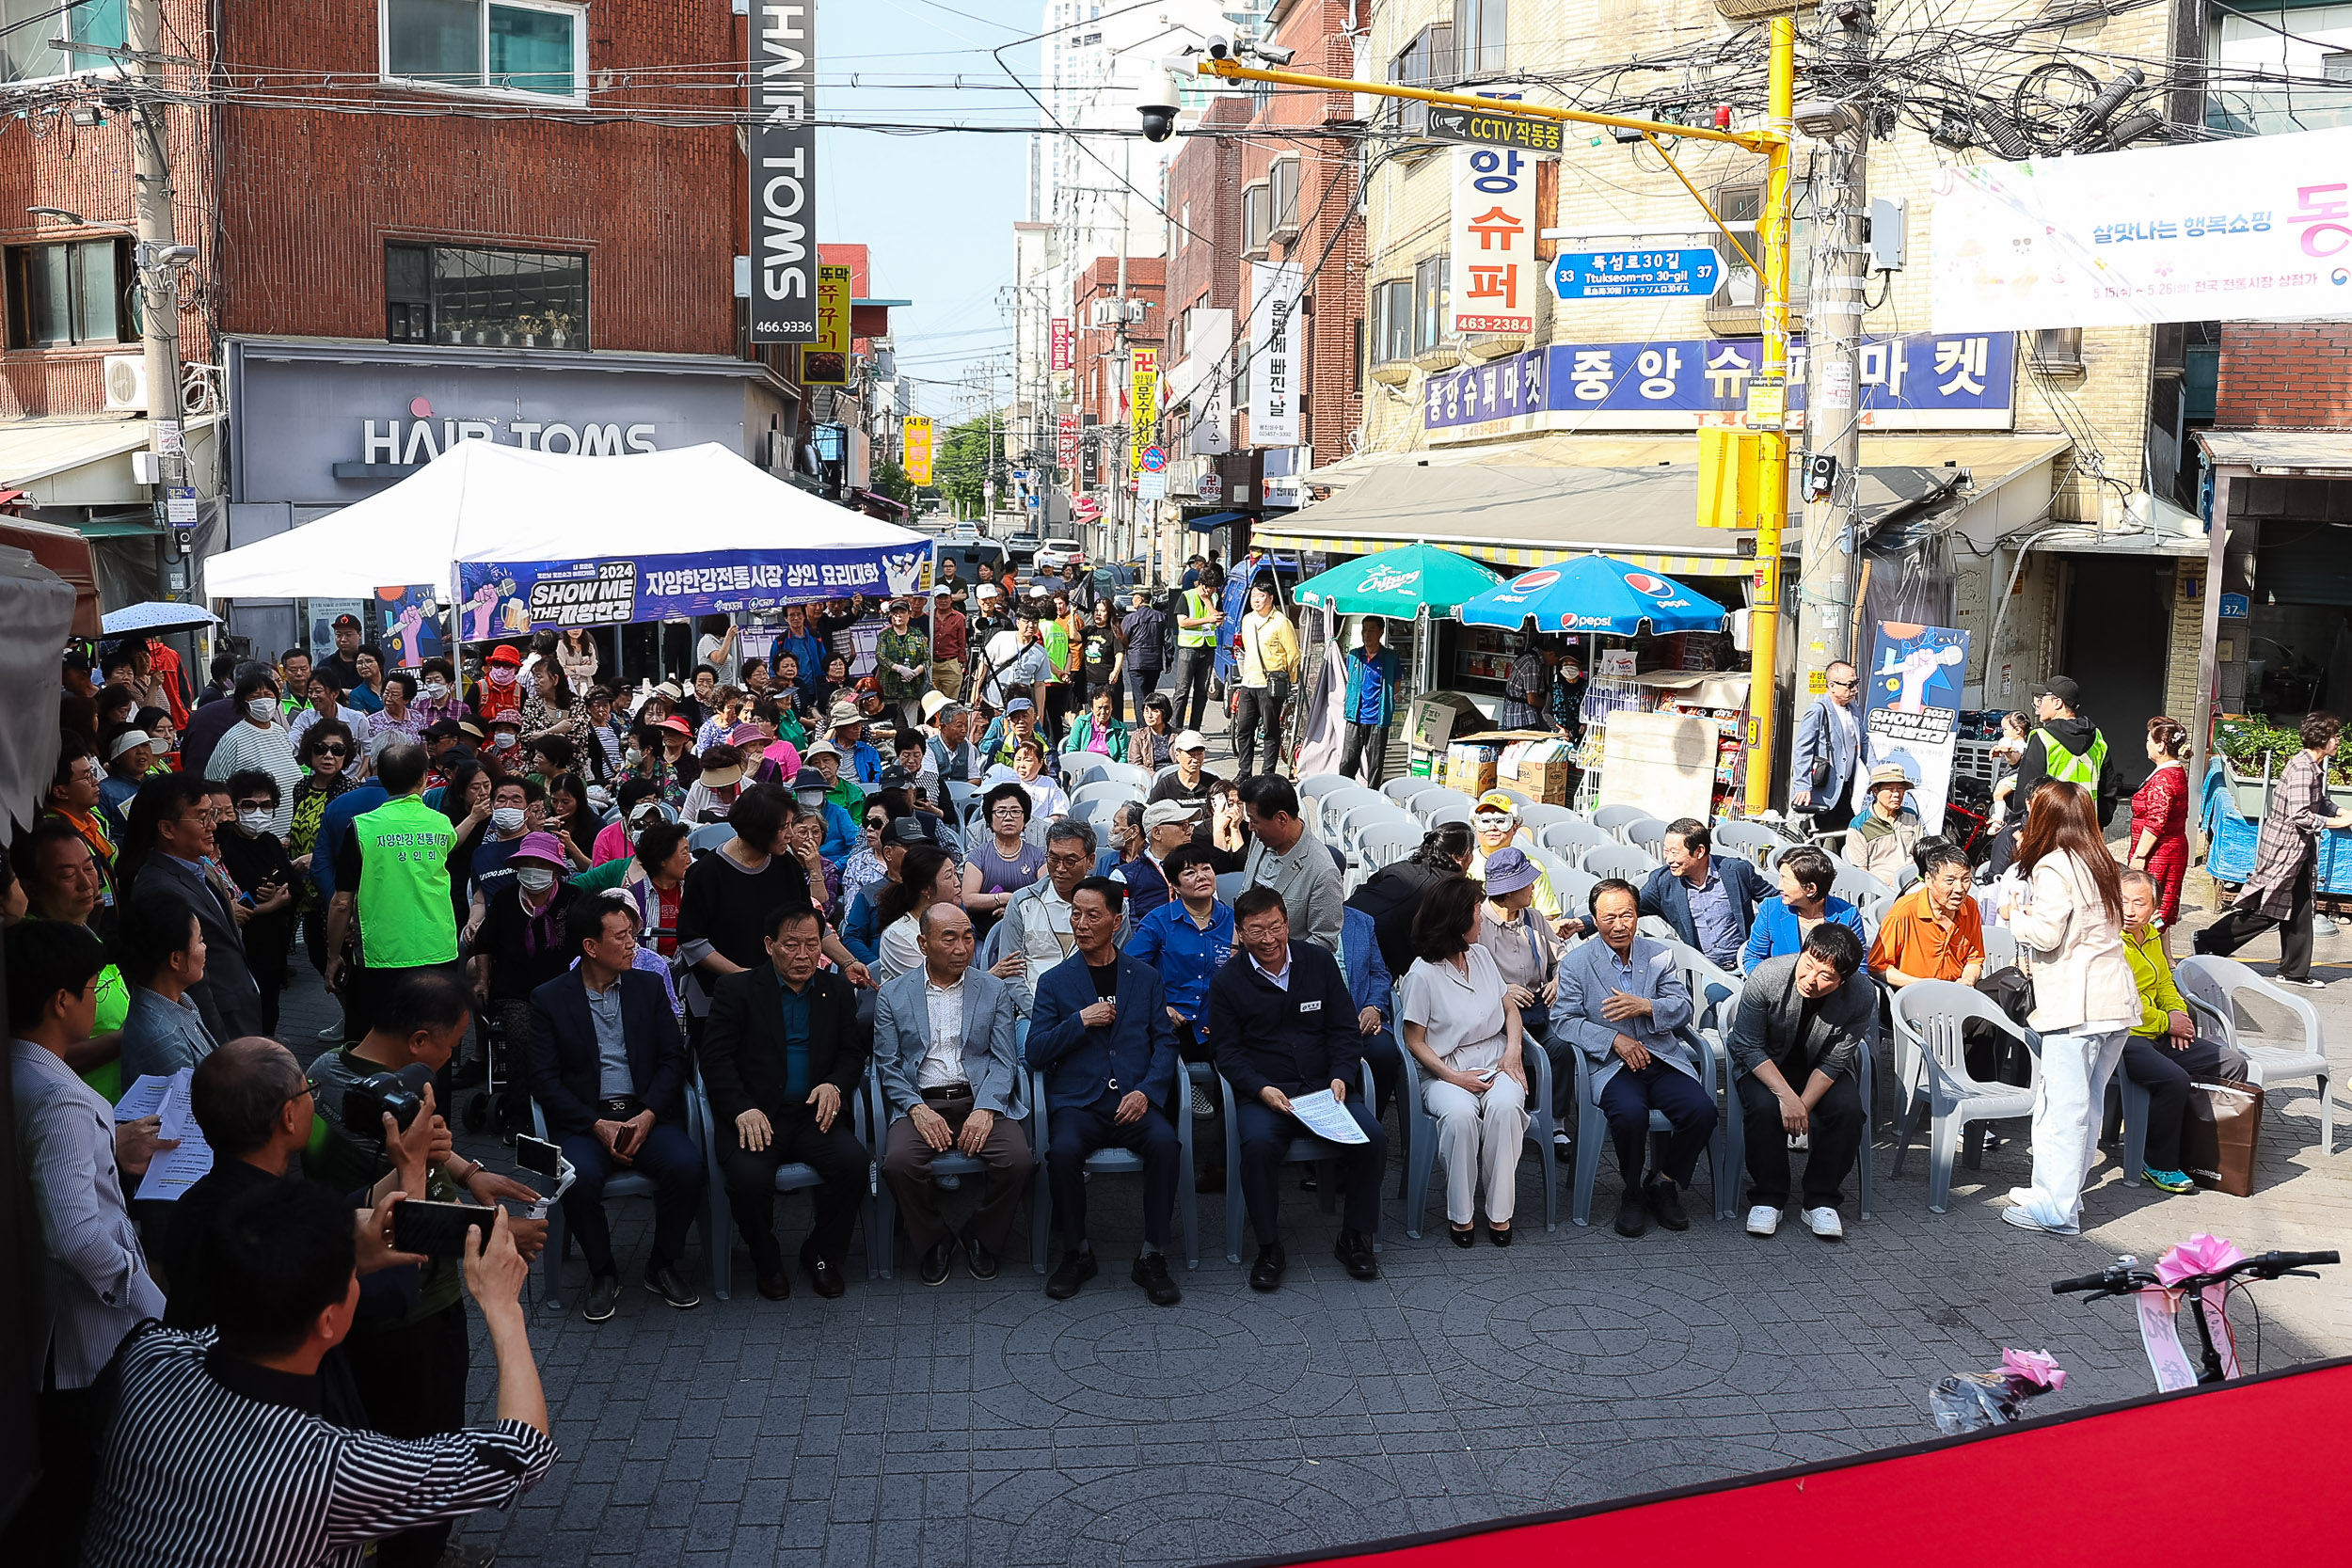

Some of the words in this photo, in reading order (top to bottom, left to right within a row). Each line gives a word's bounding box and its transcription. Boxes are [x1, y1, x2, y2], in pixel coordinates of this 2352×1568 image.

[762, 5, 805, 135] HAIR
[1470, 117, 1513, 141] CCTV
[1516, 122, 1560, 149] 작동중
[763, 147, 806, 301] TOMS
[2093, 220, 2178, 245] 살맛나는
[2184, 211, 2273, 238] 행복쇼핑
[1592, 252, 1680, 273] 뚝섬로30길
[1559, 270, 1575, 282] 33
[1584, 272, 1654, 284] Ttukseom-ro
[1656, 270, 1689, 284] 30-gil
[1696, 265, 1713, 278] 37
[2195, 279, 2219, 293] 전국
[756, 321, 813, 334] 466.9336
[1458, 316, 1530, 332] 463-2384
[1270, 359, 1287, 393] 빠진
[1429, 354, 1542, 422] 중앙슈퍼마켓
[1270, 400, 1287, 418] 날
[509, 422, 657, 457] TOMS
[909, 429, 929, 480] 부동산
[599, 564, 634, 579] 2024
[645, 564, 784, 597] 자양한강전통시장
[787, 564, 818, 588] 상인
[820, 562, 880, 587] 요리대회
[532, 582, 600, 605] SHOW
[598, 578, 634, 601] ME
[1492, 594, 1529, 604] pepsi
[532, 605, 562, 620] THE
[557, 600, 632, 625] 자양한강
[1657, 598, 1692, 610] pepsi
[2224, 604, 2239, 615] 37
[1579, 615, 1613, 628] pepsi
[1870, 710, 1923, 727] SHOW
[1920, 716, 1951, 732] ME
[1923, 708, 1953, 720] 2024
[1869, 722, 1891, 733] THE
[376, 832, 414, 847] 자양한강
